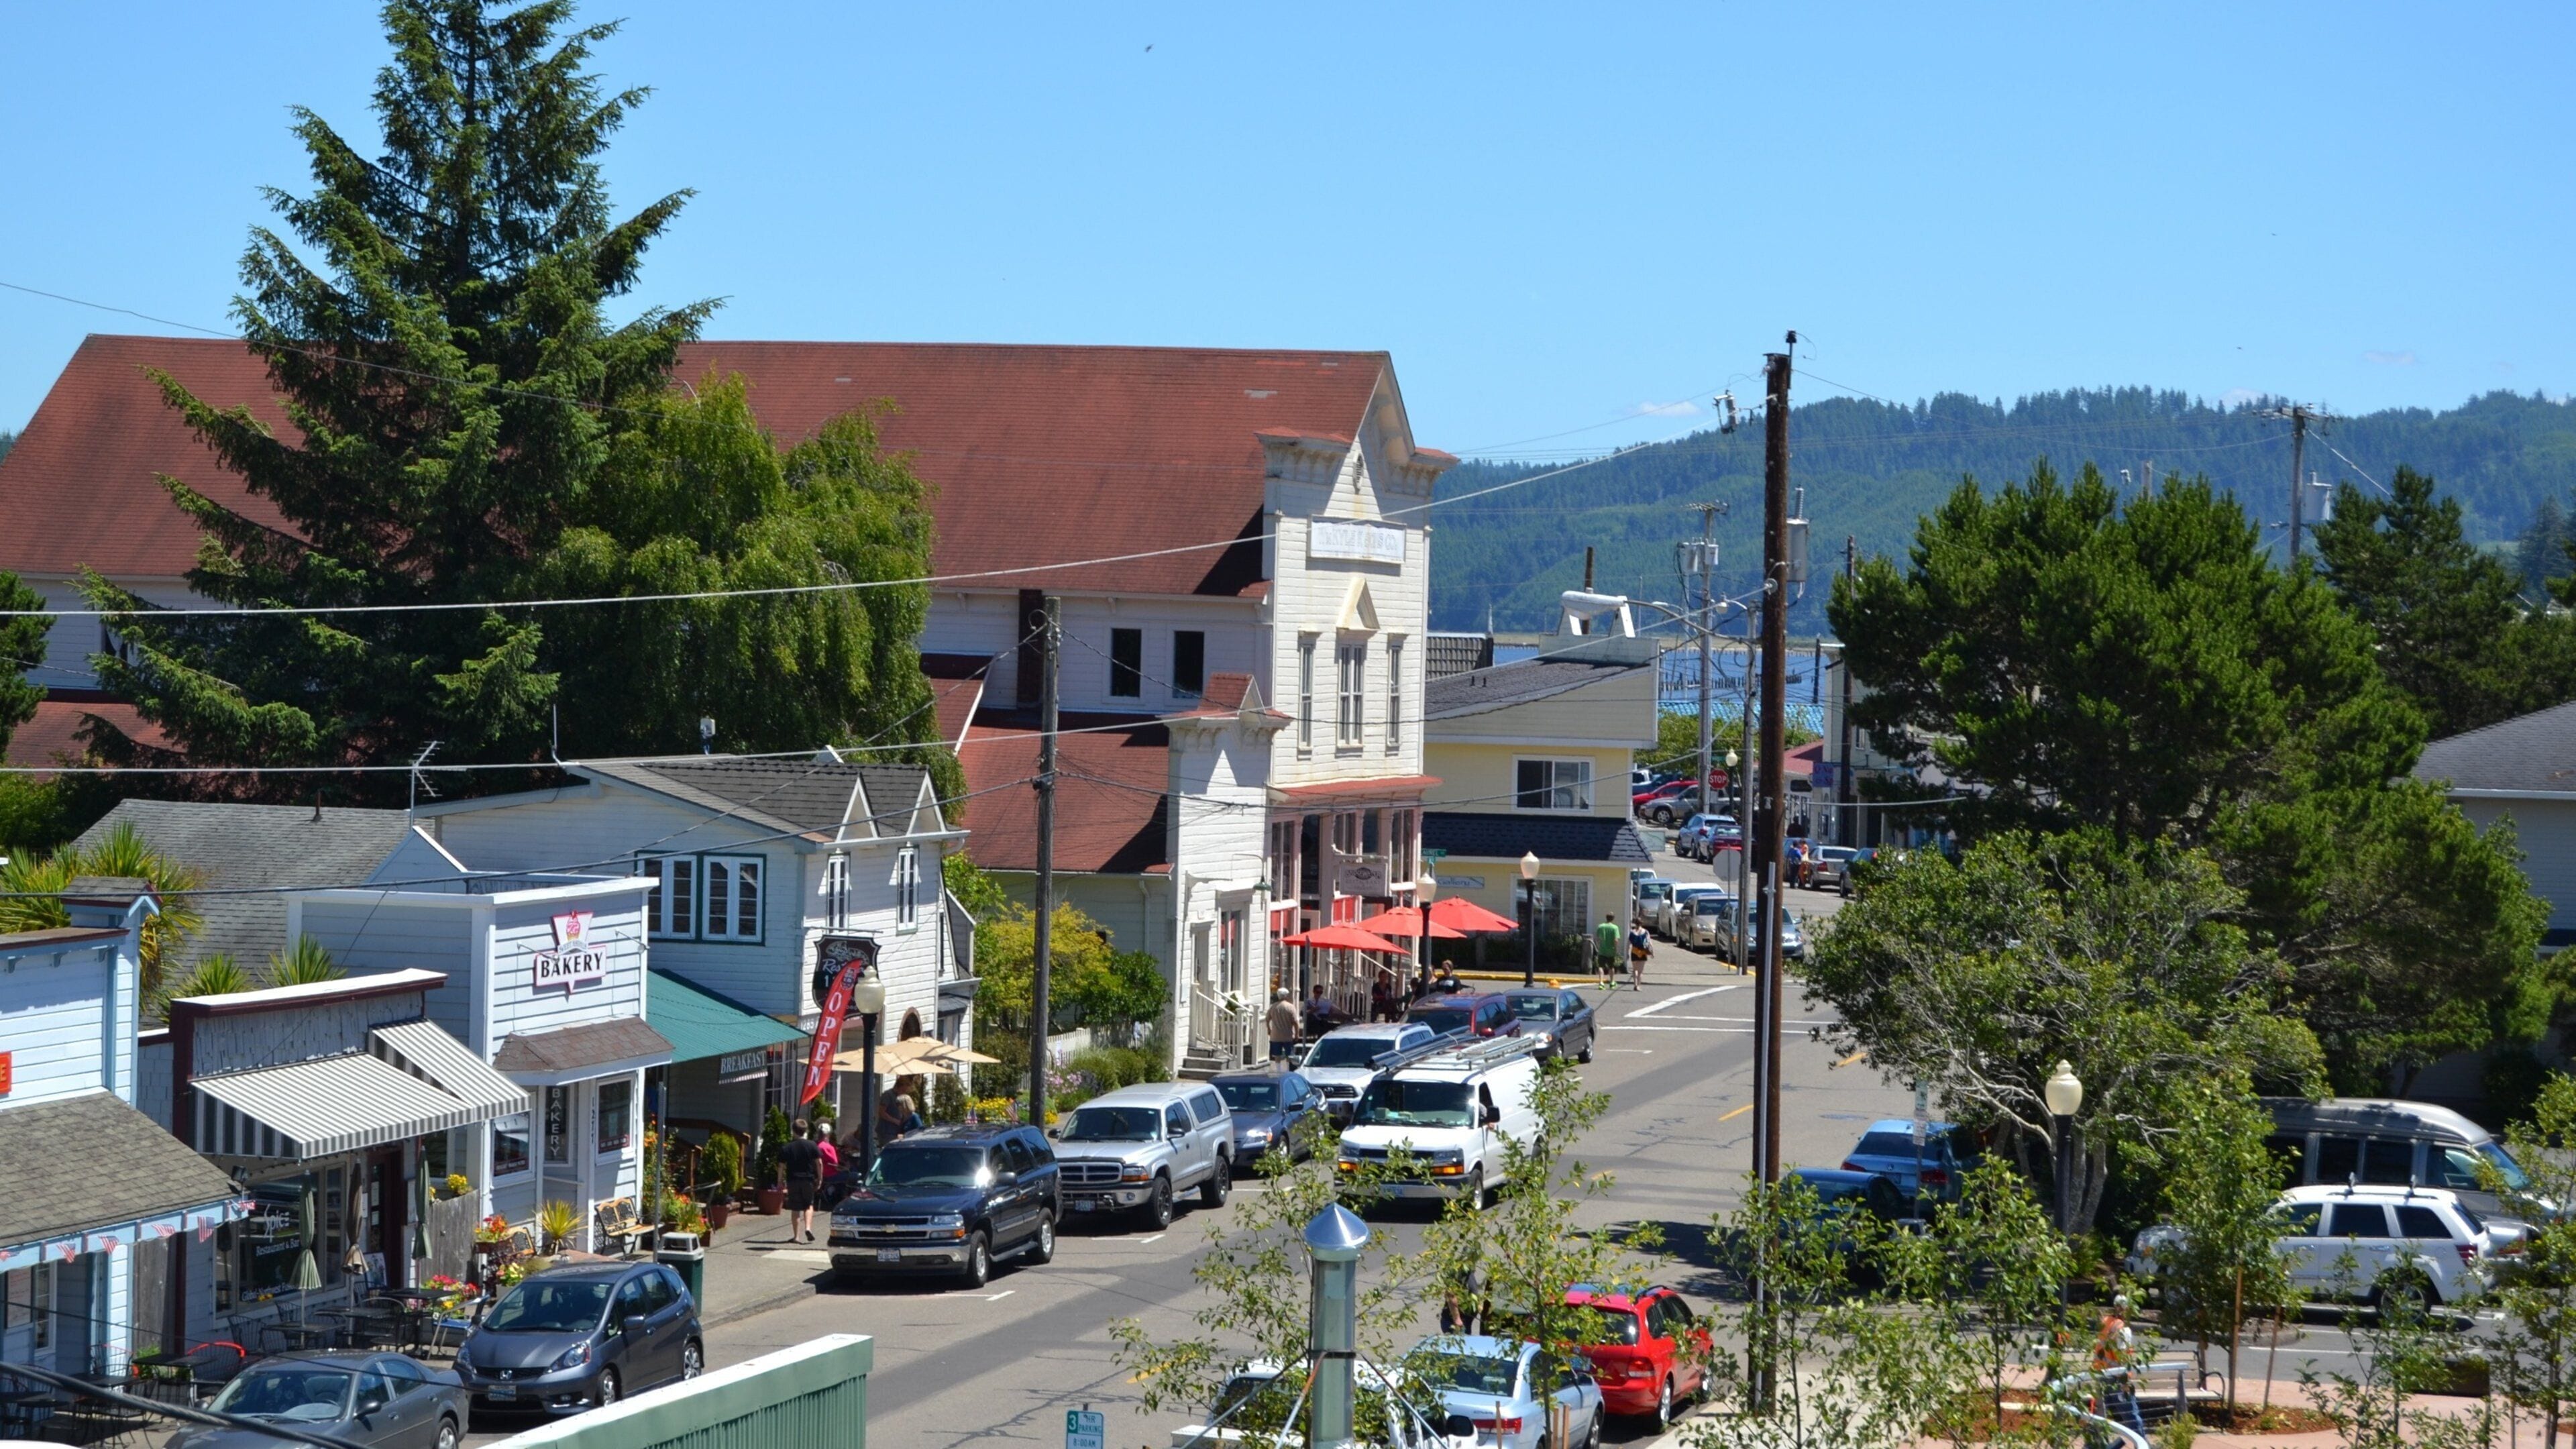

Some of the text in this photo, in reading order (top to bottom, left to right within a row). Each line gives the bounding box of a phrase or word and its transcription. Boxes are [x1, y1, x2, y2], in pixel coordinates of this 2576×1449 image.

[1710, 775, 1727, 784] STOP
[541, 953, 602, 977] BAKERY
[808, 991, 842, 1086] OPEN
[720, 1051, 766, 1074] BREAKFAST
[551, 1088, 561, 1157] BAKERY
[256, 1242, 285, 1256] Restaurant
[290, 1238, 300, 1248] Bar
[1069, 1415, 1076, 1430] 3
[1079, 1424, 1102, 1434] PARKING
